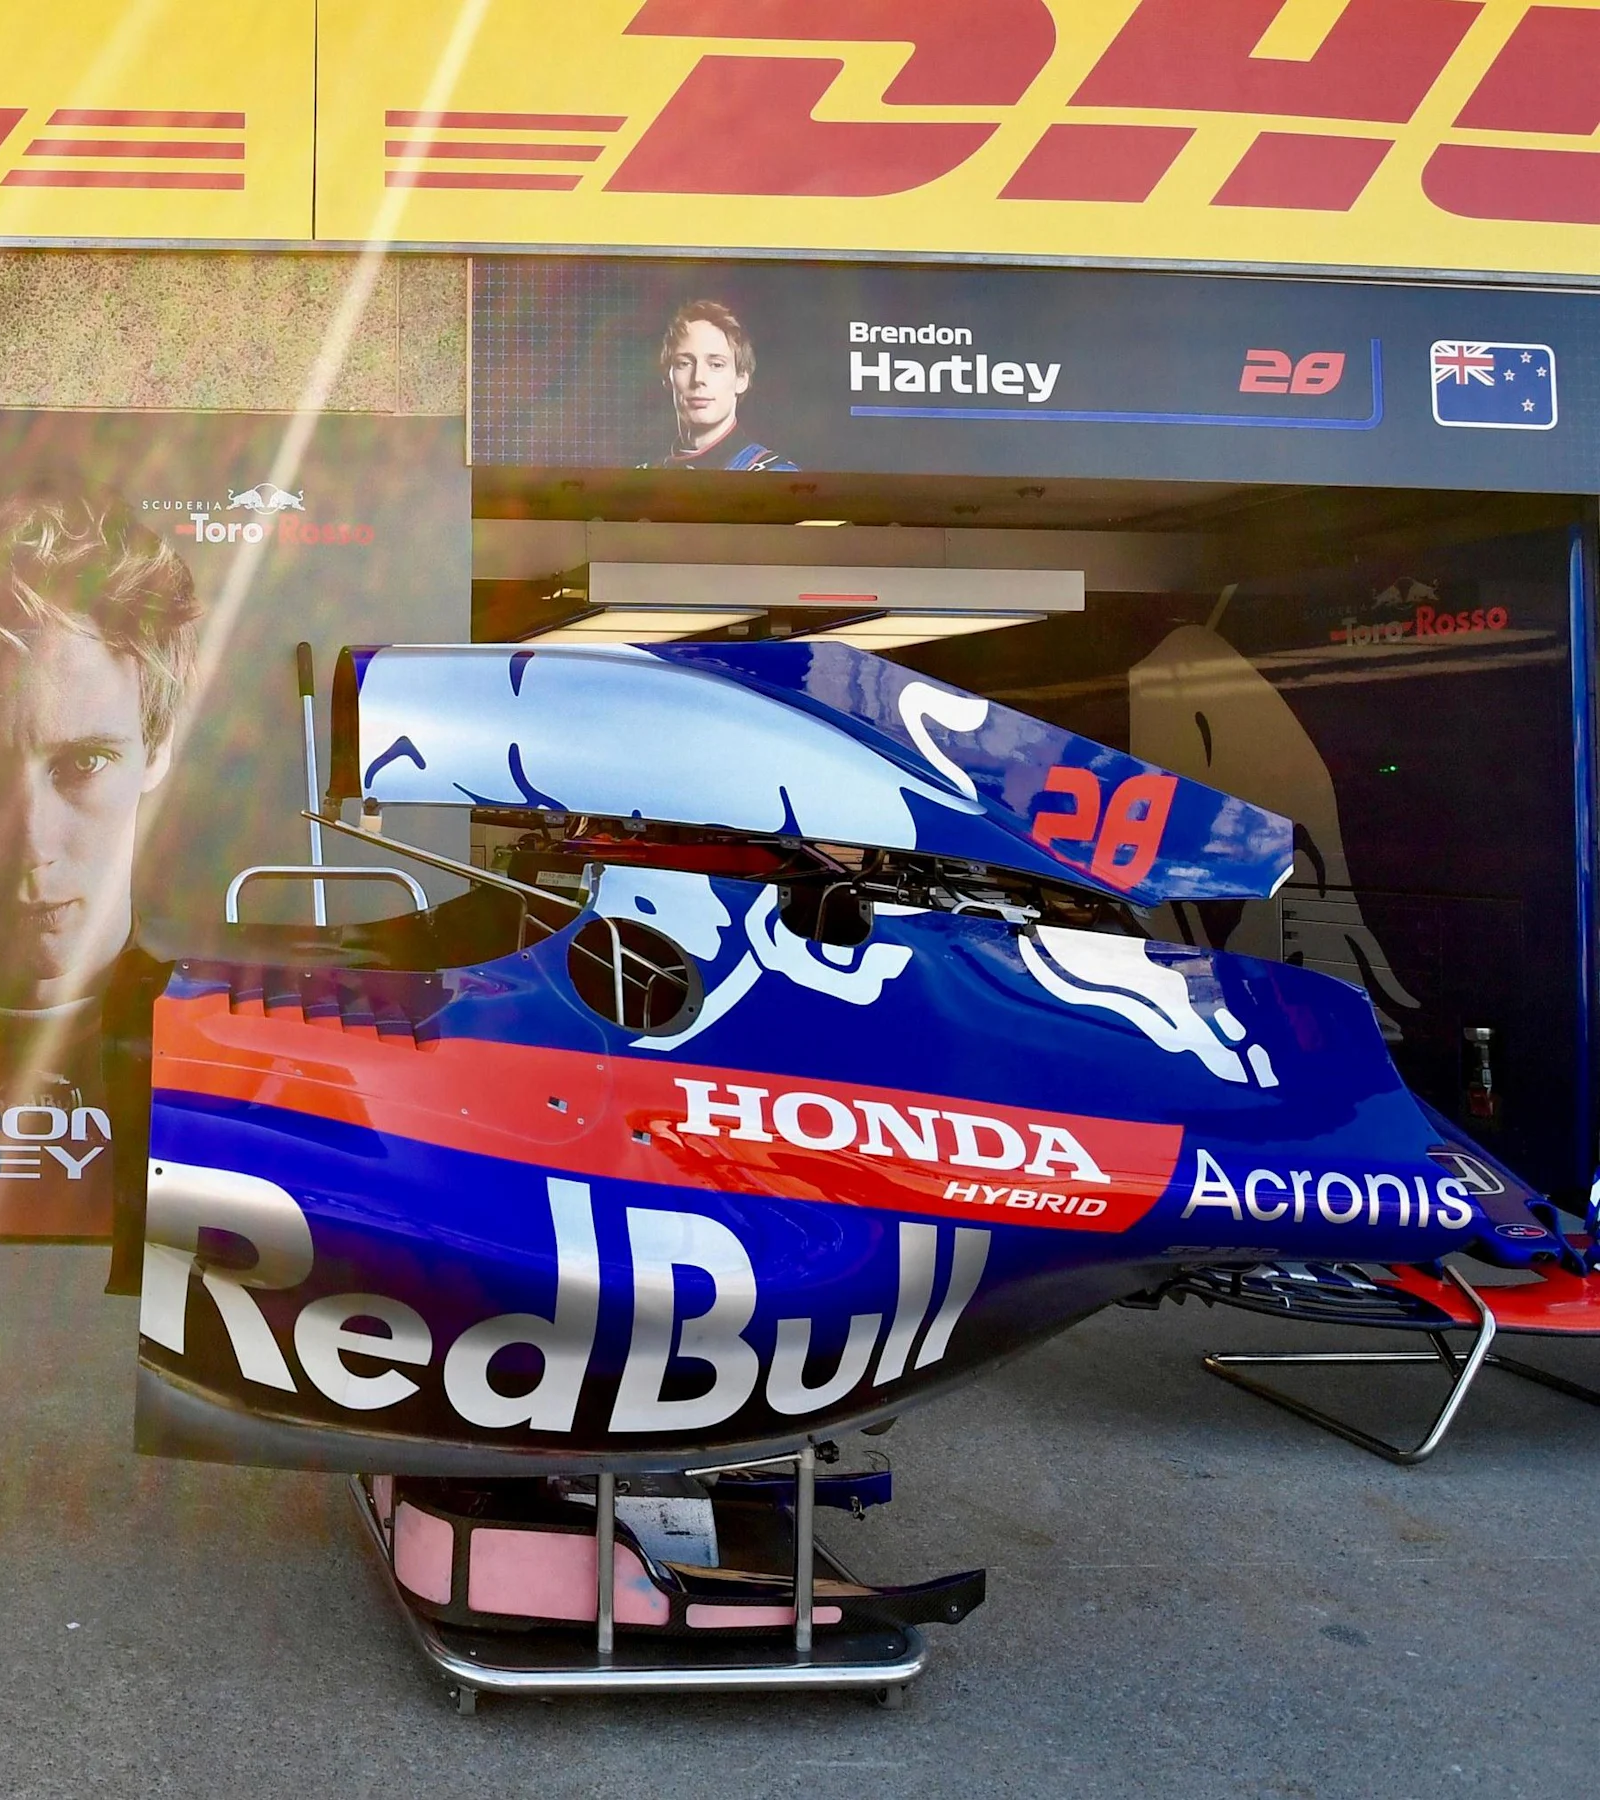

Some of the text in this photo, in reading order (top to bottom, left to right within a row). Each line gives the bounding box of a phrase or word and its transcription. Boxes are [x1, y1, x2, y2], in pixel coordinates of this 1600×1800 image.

[849, 322, 973, 346] Brendon
[849, 352, 1062, 403] Hartley
[1238, 350, 1345, 394] 28
[142, 500, 222, 511] SCUDERIA
[190, 513, 376, 546] Toro Rosso
[1342, 605, 1509, 647] Toro Rosso
[1031, 765, 1179, 892] 28
[673, 1077, 1112, 1184] HONDA
[941, 1178, 1108, 1219] HYBRID
[1180, 1148, 1473, 1231] Acronis
